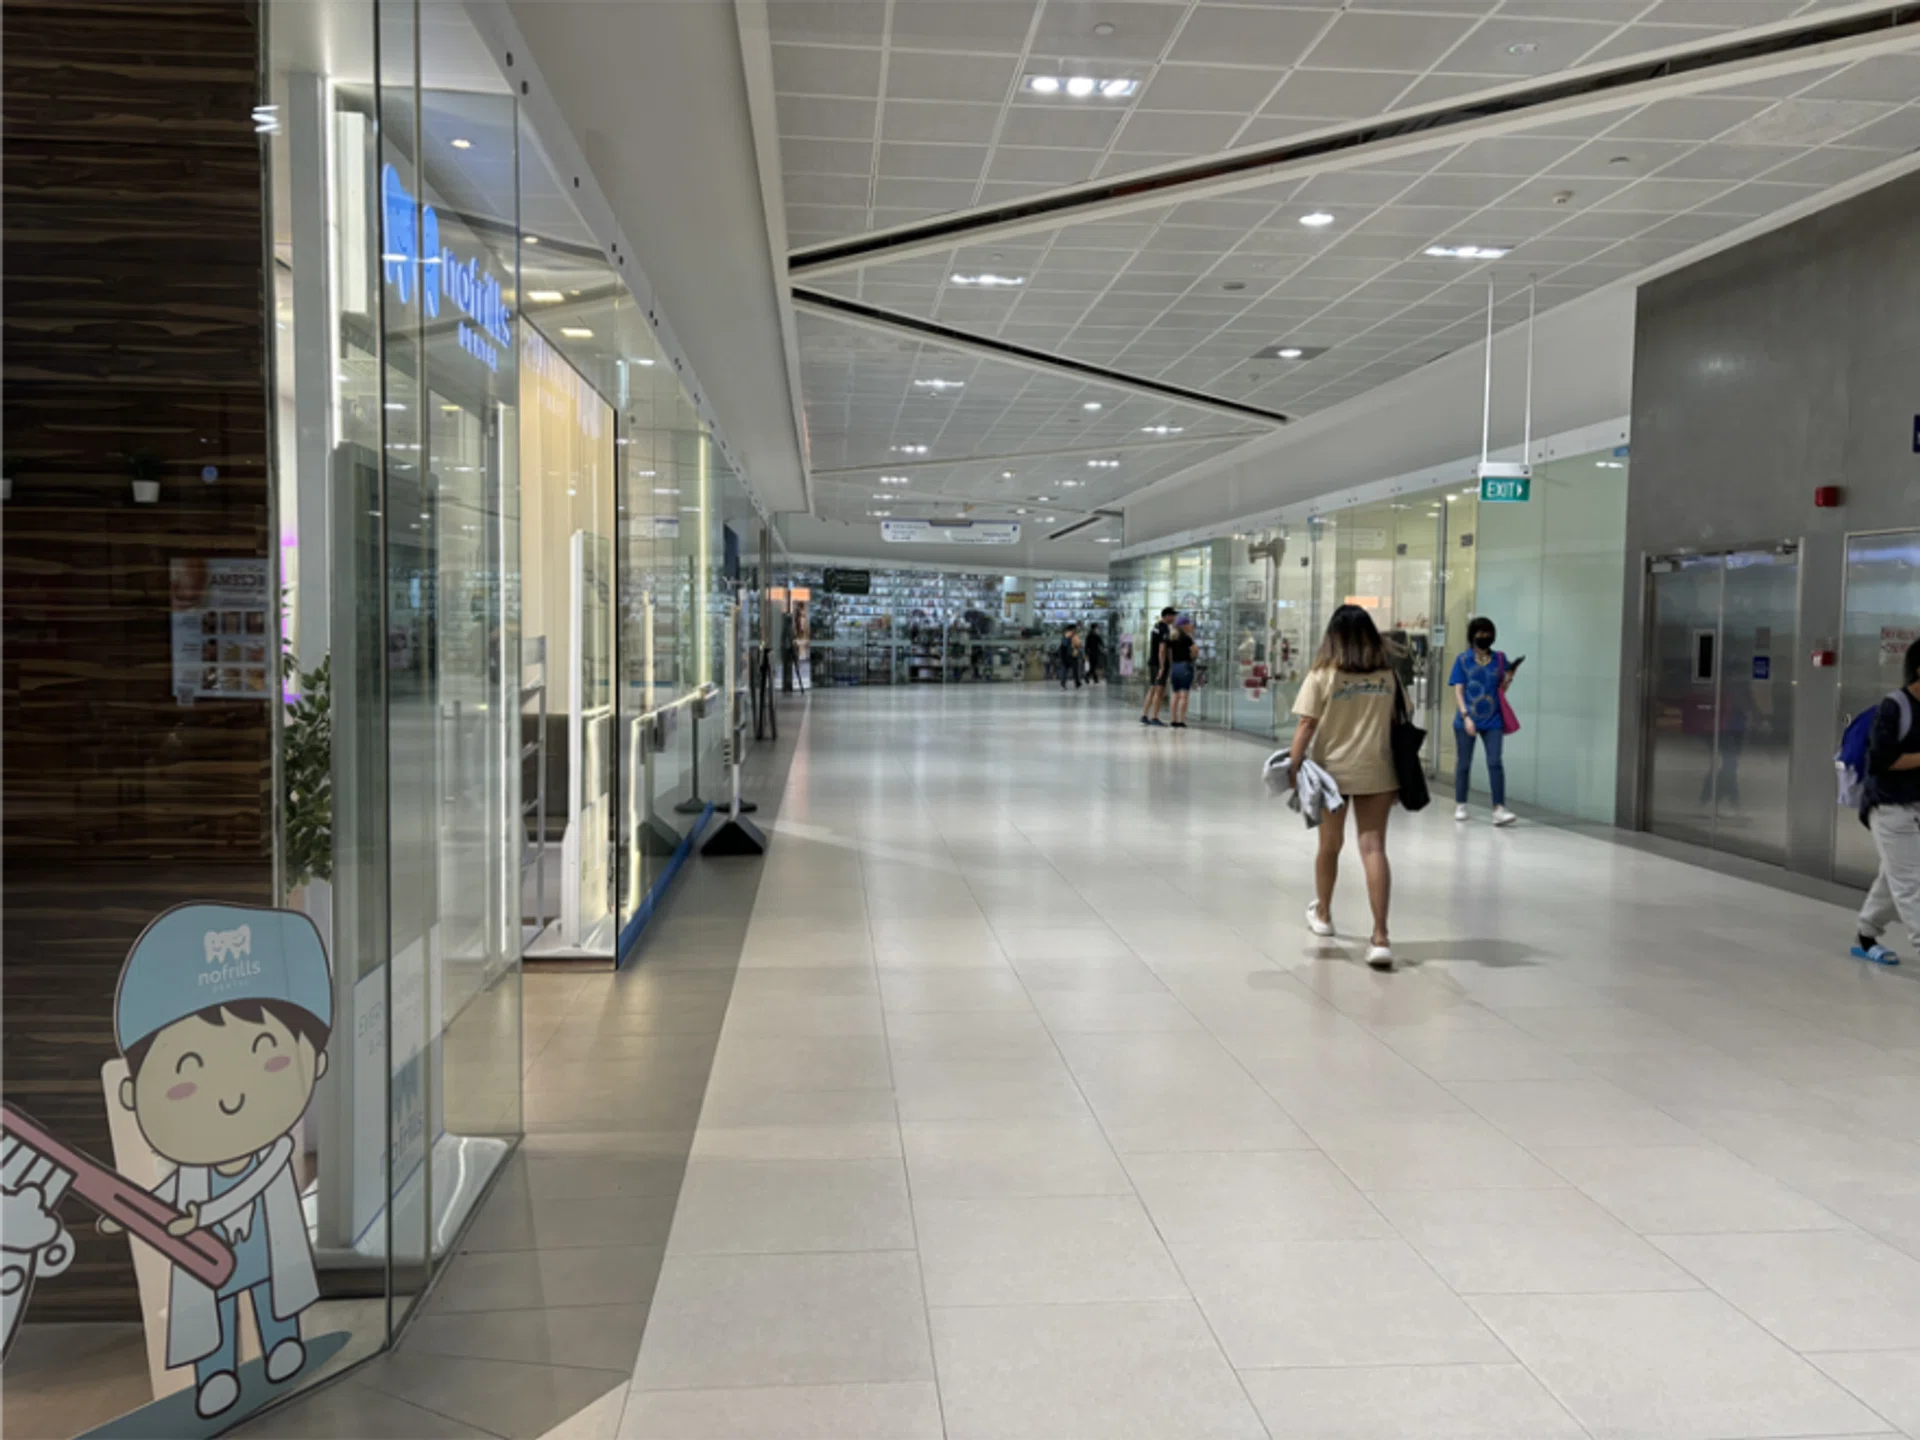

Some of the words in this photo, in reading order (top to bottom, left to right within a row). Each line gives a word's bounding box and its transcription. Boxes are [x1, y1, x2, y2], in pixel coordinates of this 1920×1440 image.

[442, 247, 511, 348] nofrills
[1487, 481, 1515, 498] EXIT
[198, 959, 261, 987] nofrills
